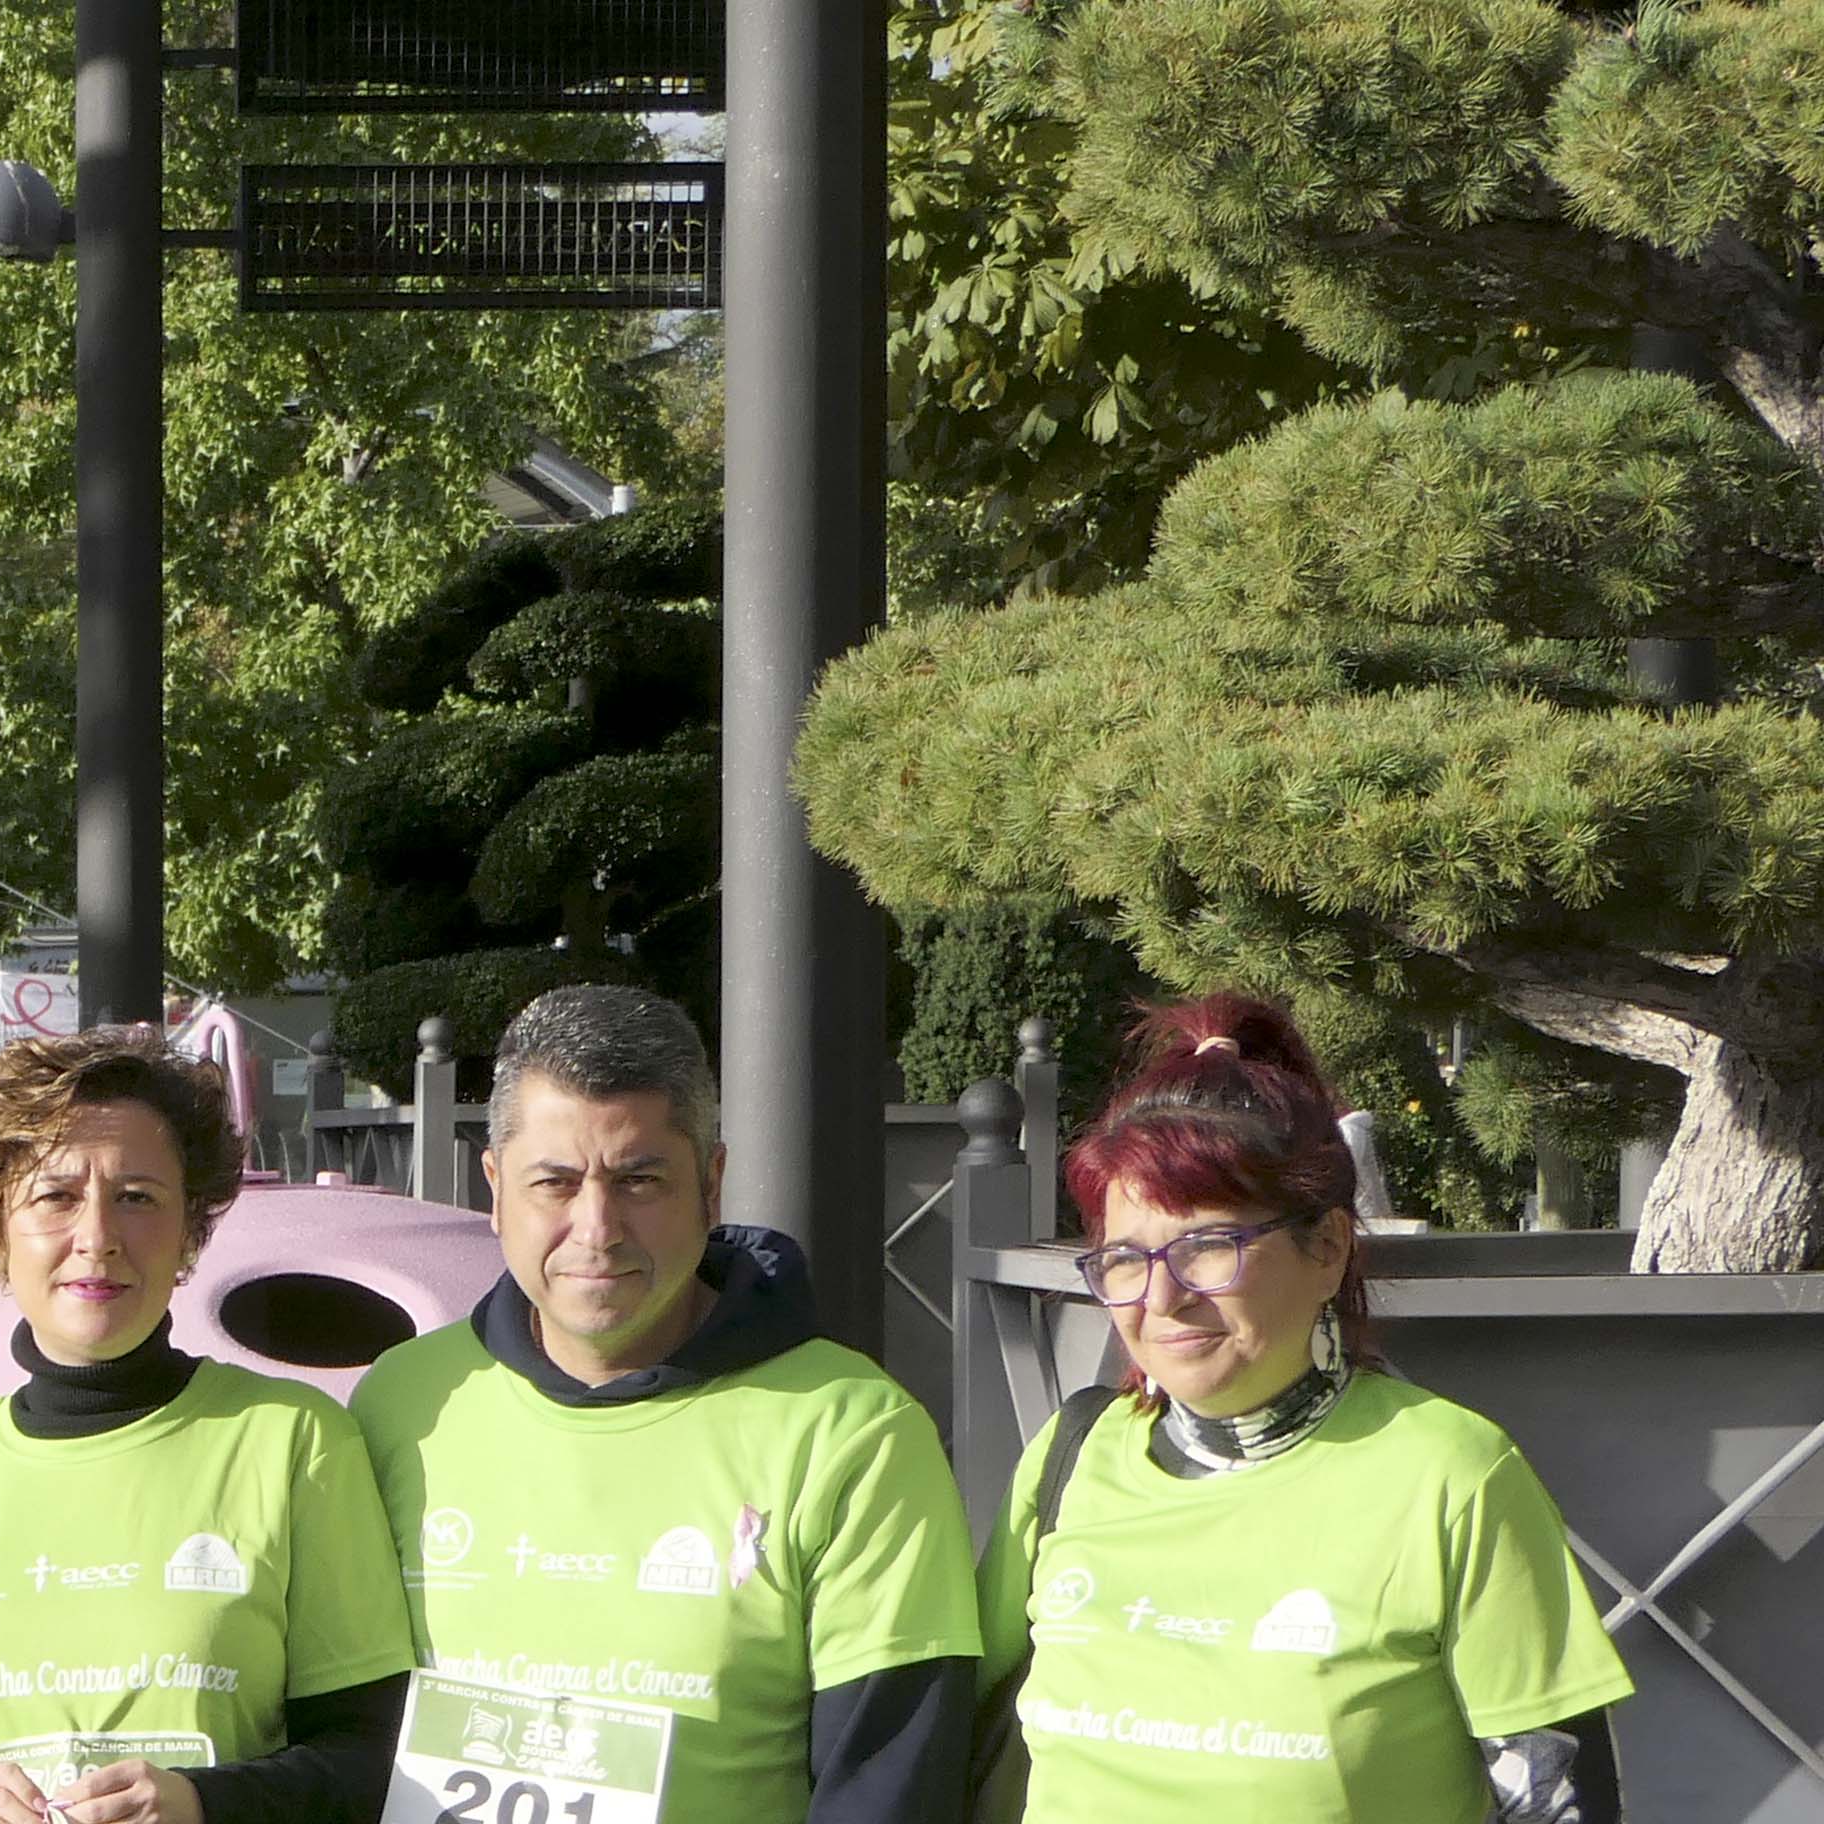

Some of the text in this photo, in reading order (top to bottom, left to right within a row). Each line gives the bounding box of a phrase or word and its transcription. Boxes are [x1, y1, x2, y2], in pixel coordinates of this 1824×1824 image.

[59, 1560, 143, 1586] aecc
[537, 1548, 617, 1574] aecc
[1154, 1614, 1235, 1637] aecc
[36, 1659, 125, 1696] Contra
[125, 1653, 151, 1691] el
[155, 1651, 241, 1696] Cáncer
[505, 1651, 714, 1700] Contra el Cáncer
[436, 1681, 490, 1702] MARCHA
[606, 1710, 624, 1723] DE
[626, 1712, 663, 1730] MAMA
[144, 1741, 163, 1753] DE
[163, 1740, 203, 1753] MAMA
[1112, 1707, 1329, 1760] Contra el Cáncer
